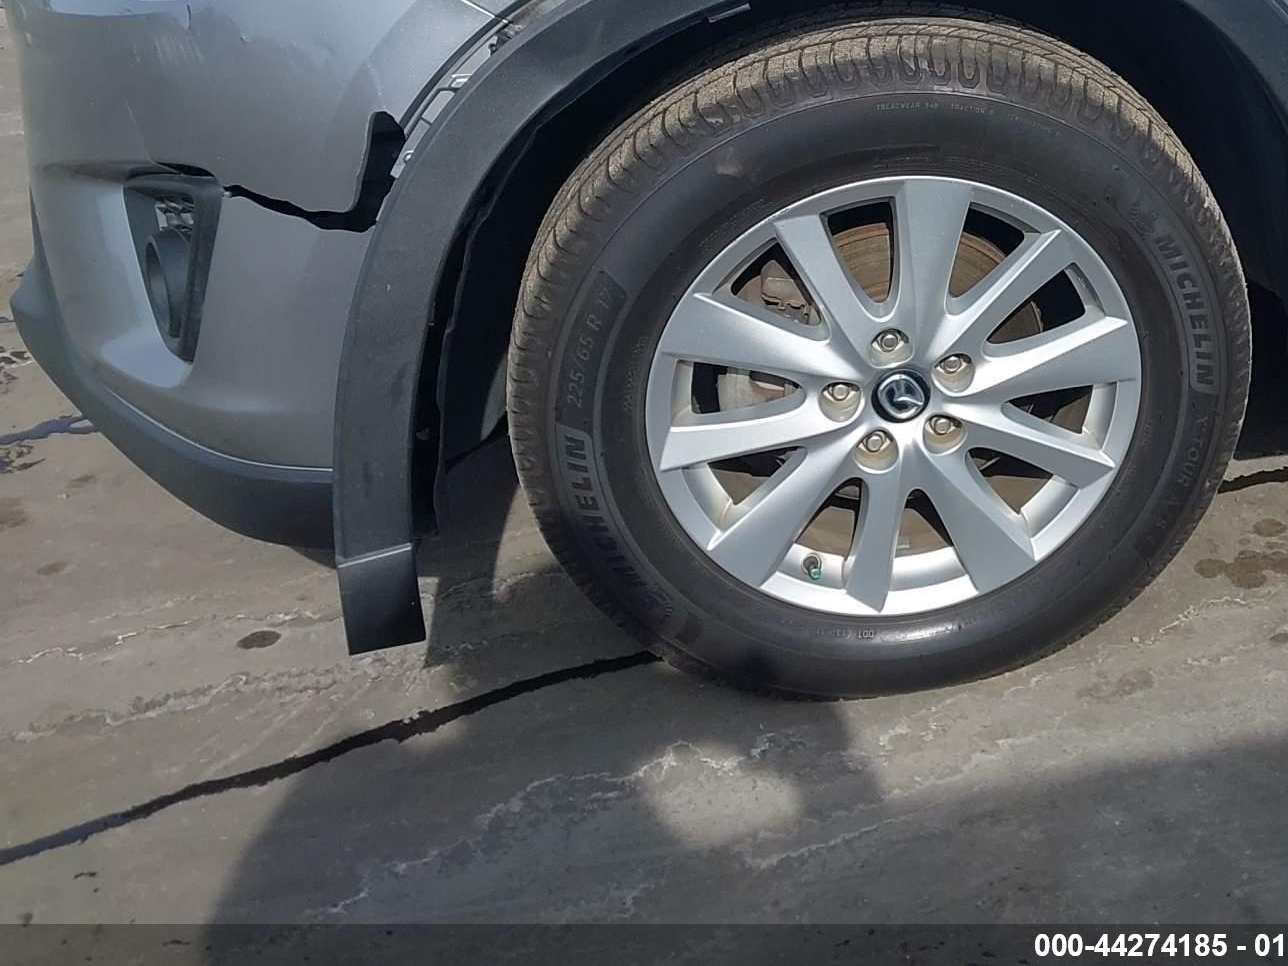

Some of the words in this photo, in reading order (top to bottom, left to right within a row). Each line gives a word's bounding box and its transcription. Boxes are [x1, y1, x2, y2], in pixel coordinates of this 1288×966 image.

[1154, 235, 1215, 386] MICHELIN
[566, 335, 594, 409] 225/65
[586, 314, 602, 332] R
[1177, 437, 1203, 487] TOUR
